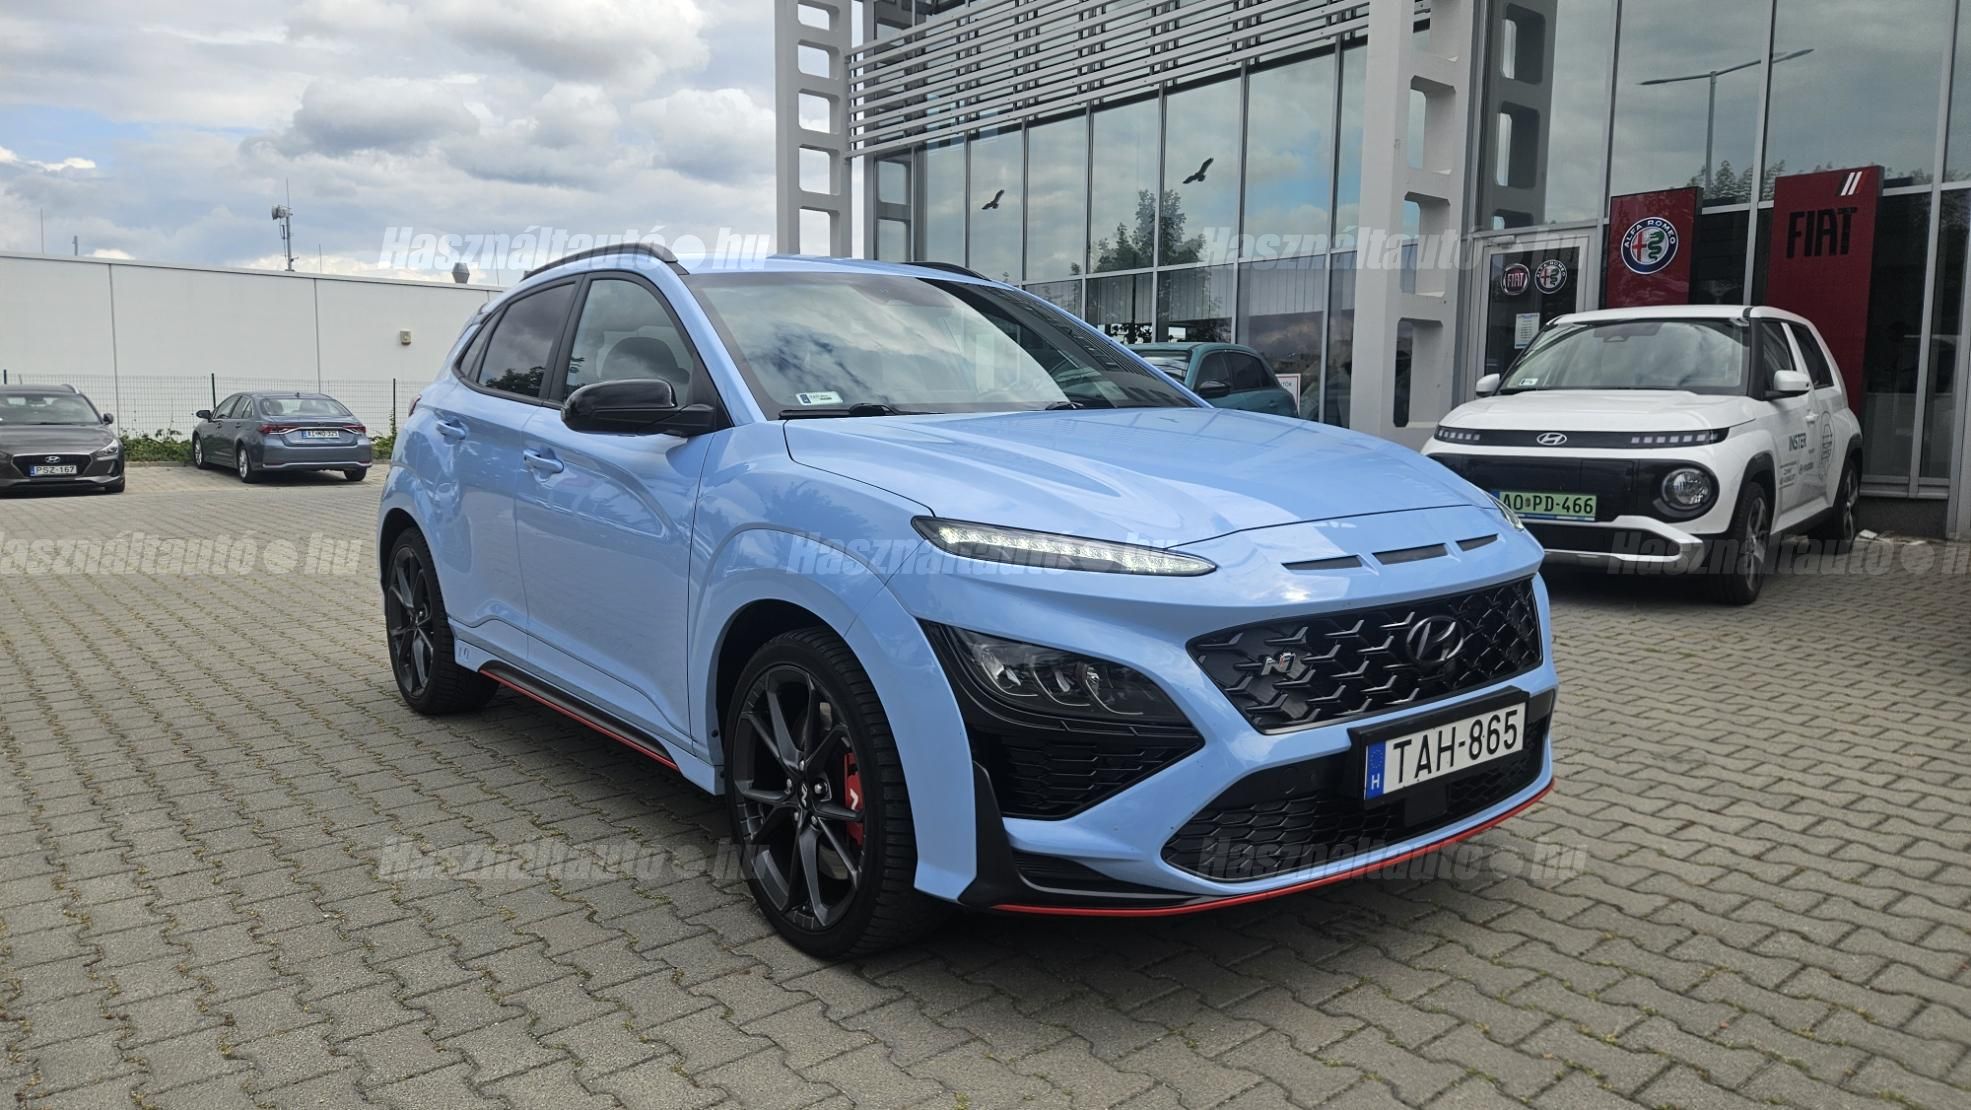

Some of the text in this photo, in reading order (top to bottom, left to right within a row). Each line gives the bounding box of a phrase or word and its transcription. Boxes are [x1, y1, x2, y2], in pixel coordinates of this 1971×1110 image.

[1624, 220, 1676, 248] ALFA ROMEO
[1787, 207, 1857, 258] FIAT
[1507, 272, 1525, 288] FIAT
[1503, 494, 1593, 514] AO PD-466
[1393, 709, 1518, 784] TAH-865
[1371, 773, 1381, 790] H
